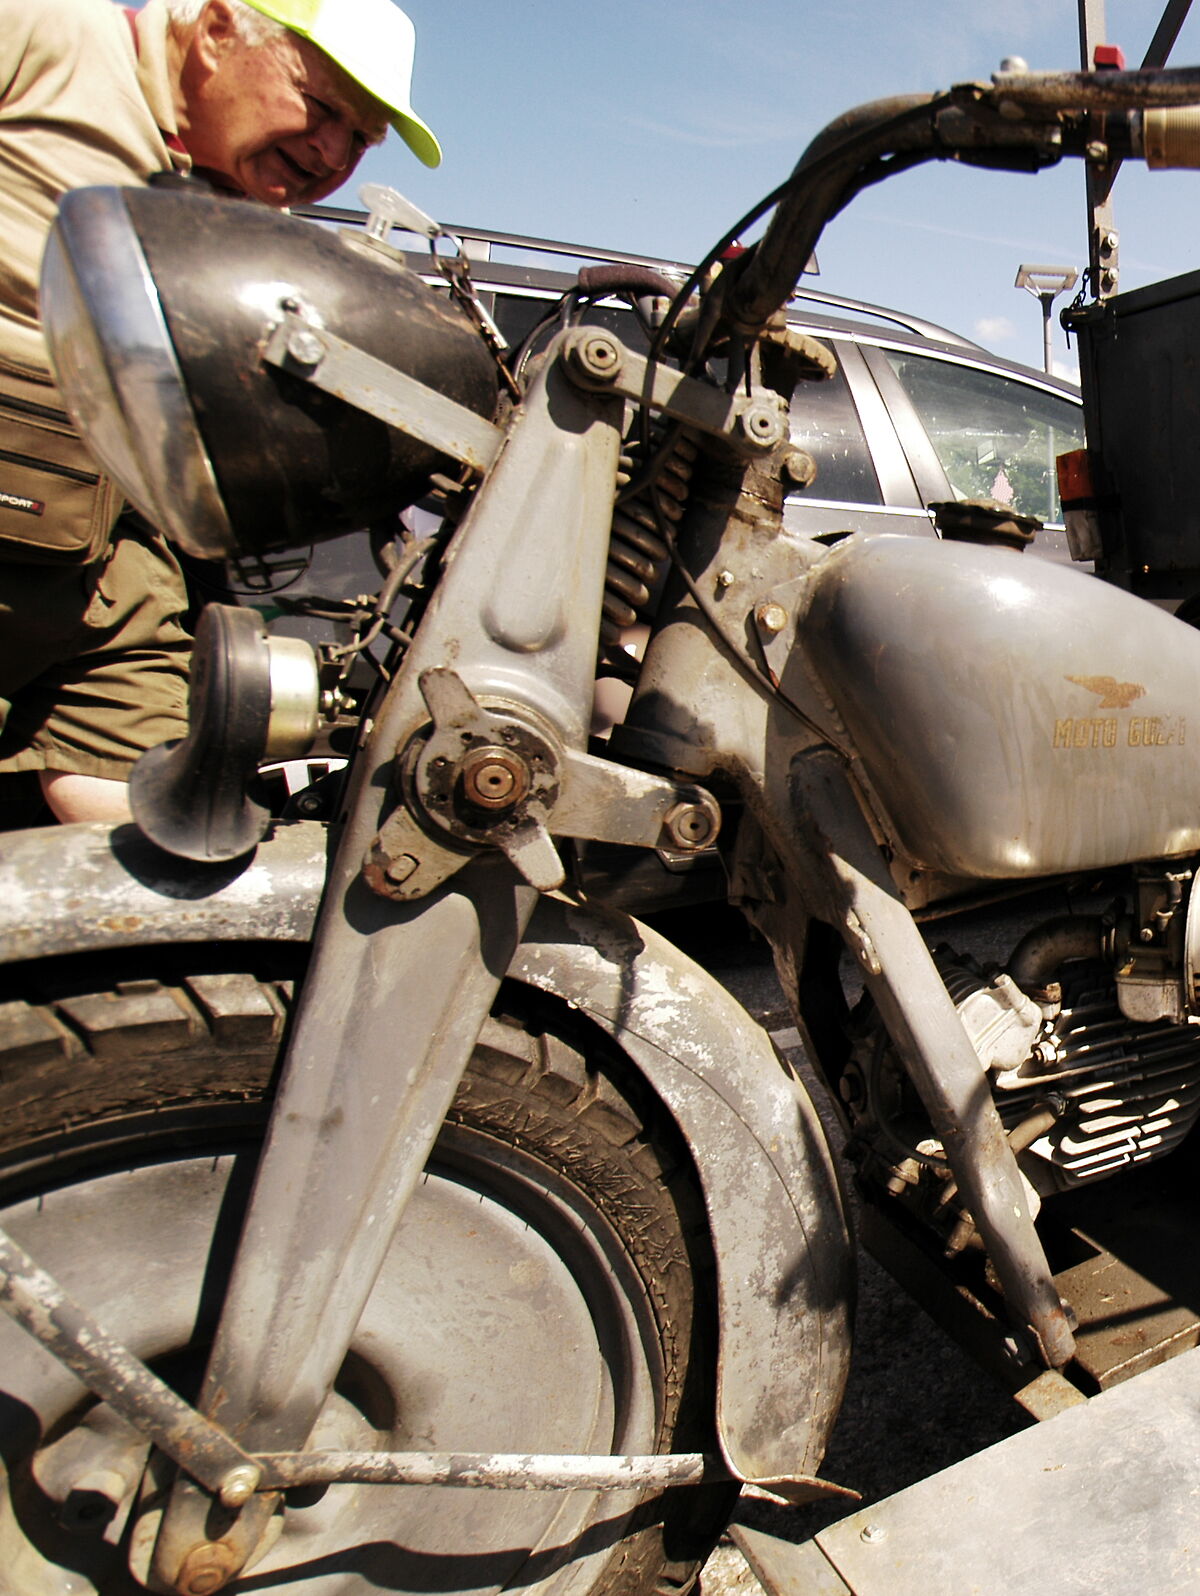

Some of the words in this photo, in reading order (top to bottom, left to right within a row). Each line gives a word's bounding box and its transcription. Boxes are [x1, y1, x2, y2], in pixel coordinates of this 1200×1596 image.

[0, 493, 34, 509] PORT
[1052, 717, 1118, 749] MOTO
[1127, 715, 1186, 748] GUZI
